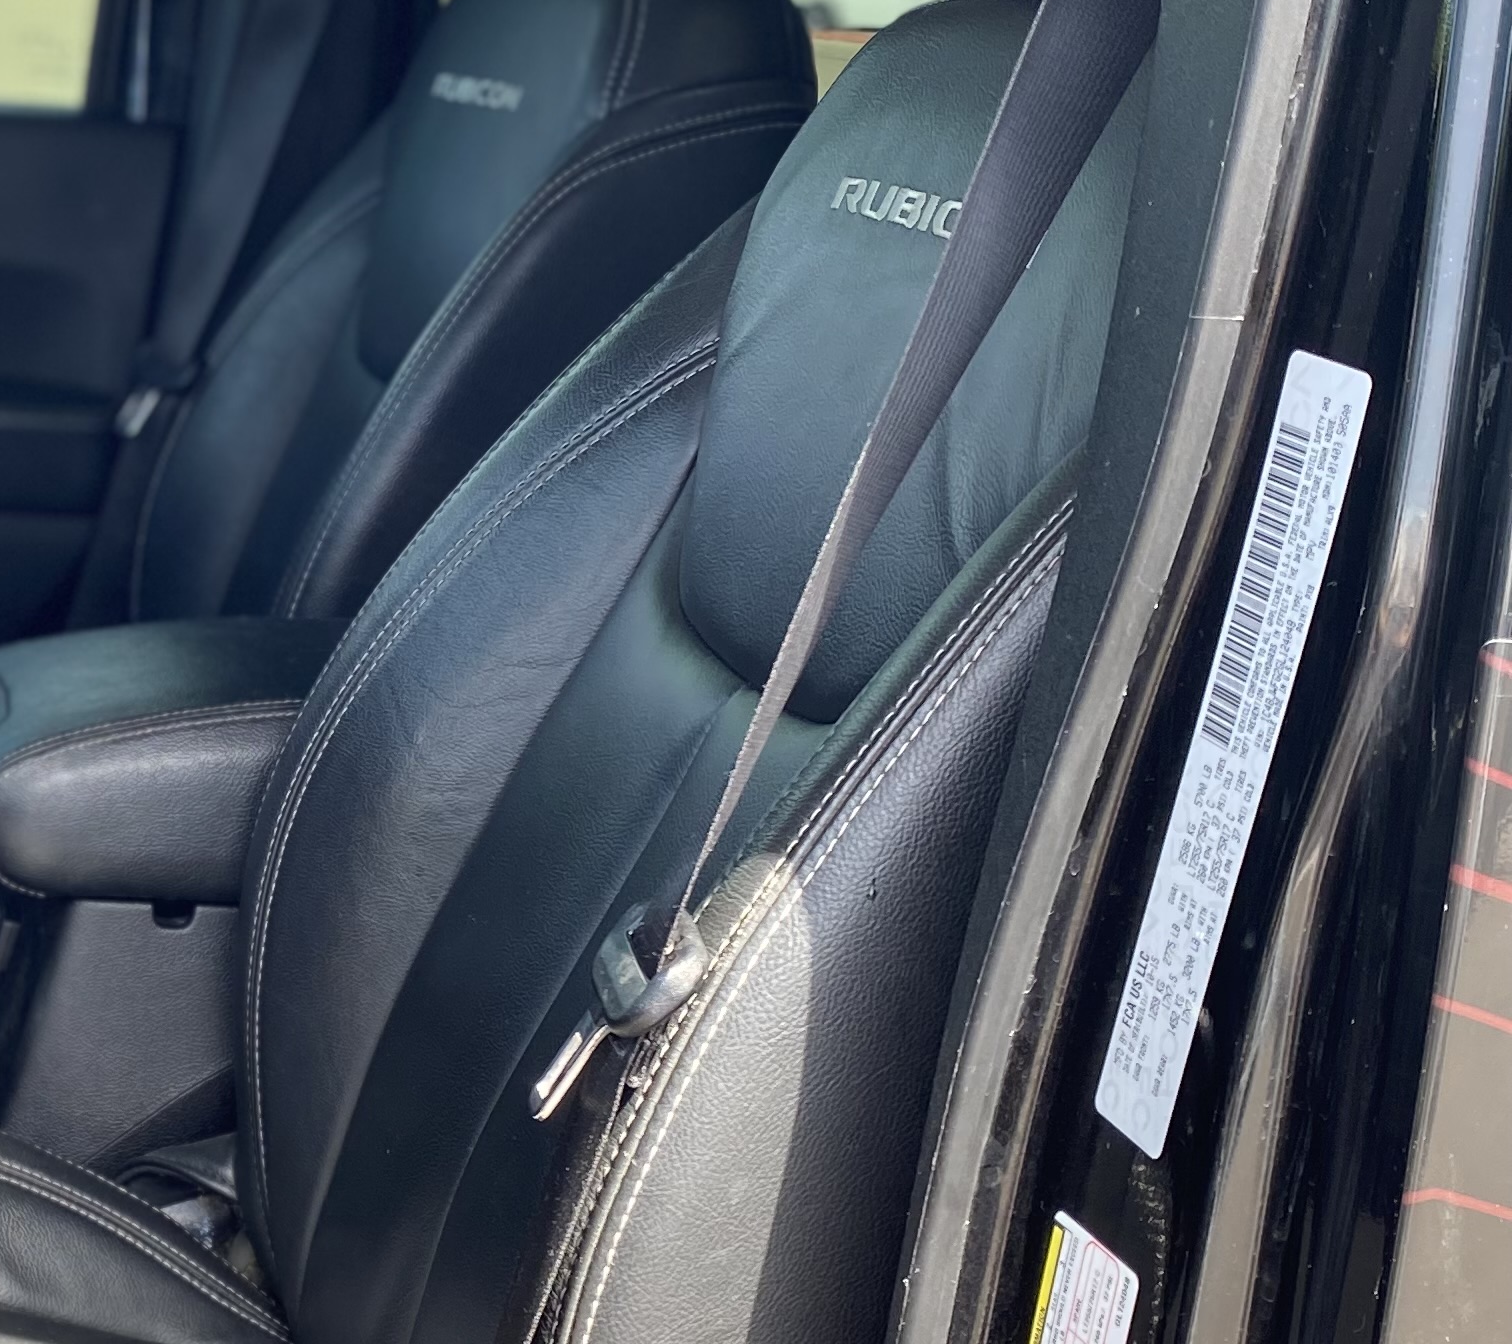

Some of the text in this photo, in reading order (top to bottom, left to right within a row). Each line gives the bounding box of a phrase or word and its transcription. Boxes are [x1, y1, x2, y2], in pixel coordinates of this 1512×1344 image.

[830, 176, 963, 240] RUBIC
[1304, 539, 1318, 561] MPV
[1185, 820, 1196, 837] KG
[1201, 763, 1212, 779] LB
[1210, 814, 1221, 830] 37
[1231, 827, 1242, 843] 37
[1134, 949, 1150, 978] LLC
[1154, 977, 1165, 994] KG
[1169, 922, 1180, 939] LB
[1173, 992, 1184, 1008] KG
[1189, 936, 1200, 953] LB
[1129, 977, 1142, 1000] US
[1121, 999, 1136, 1029] FCA
